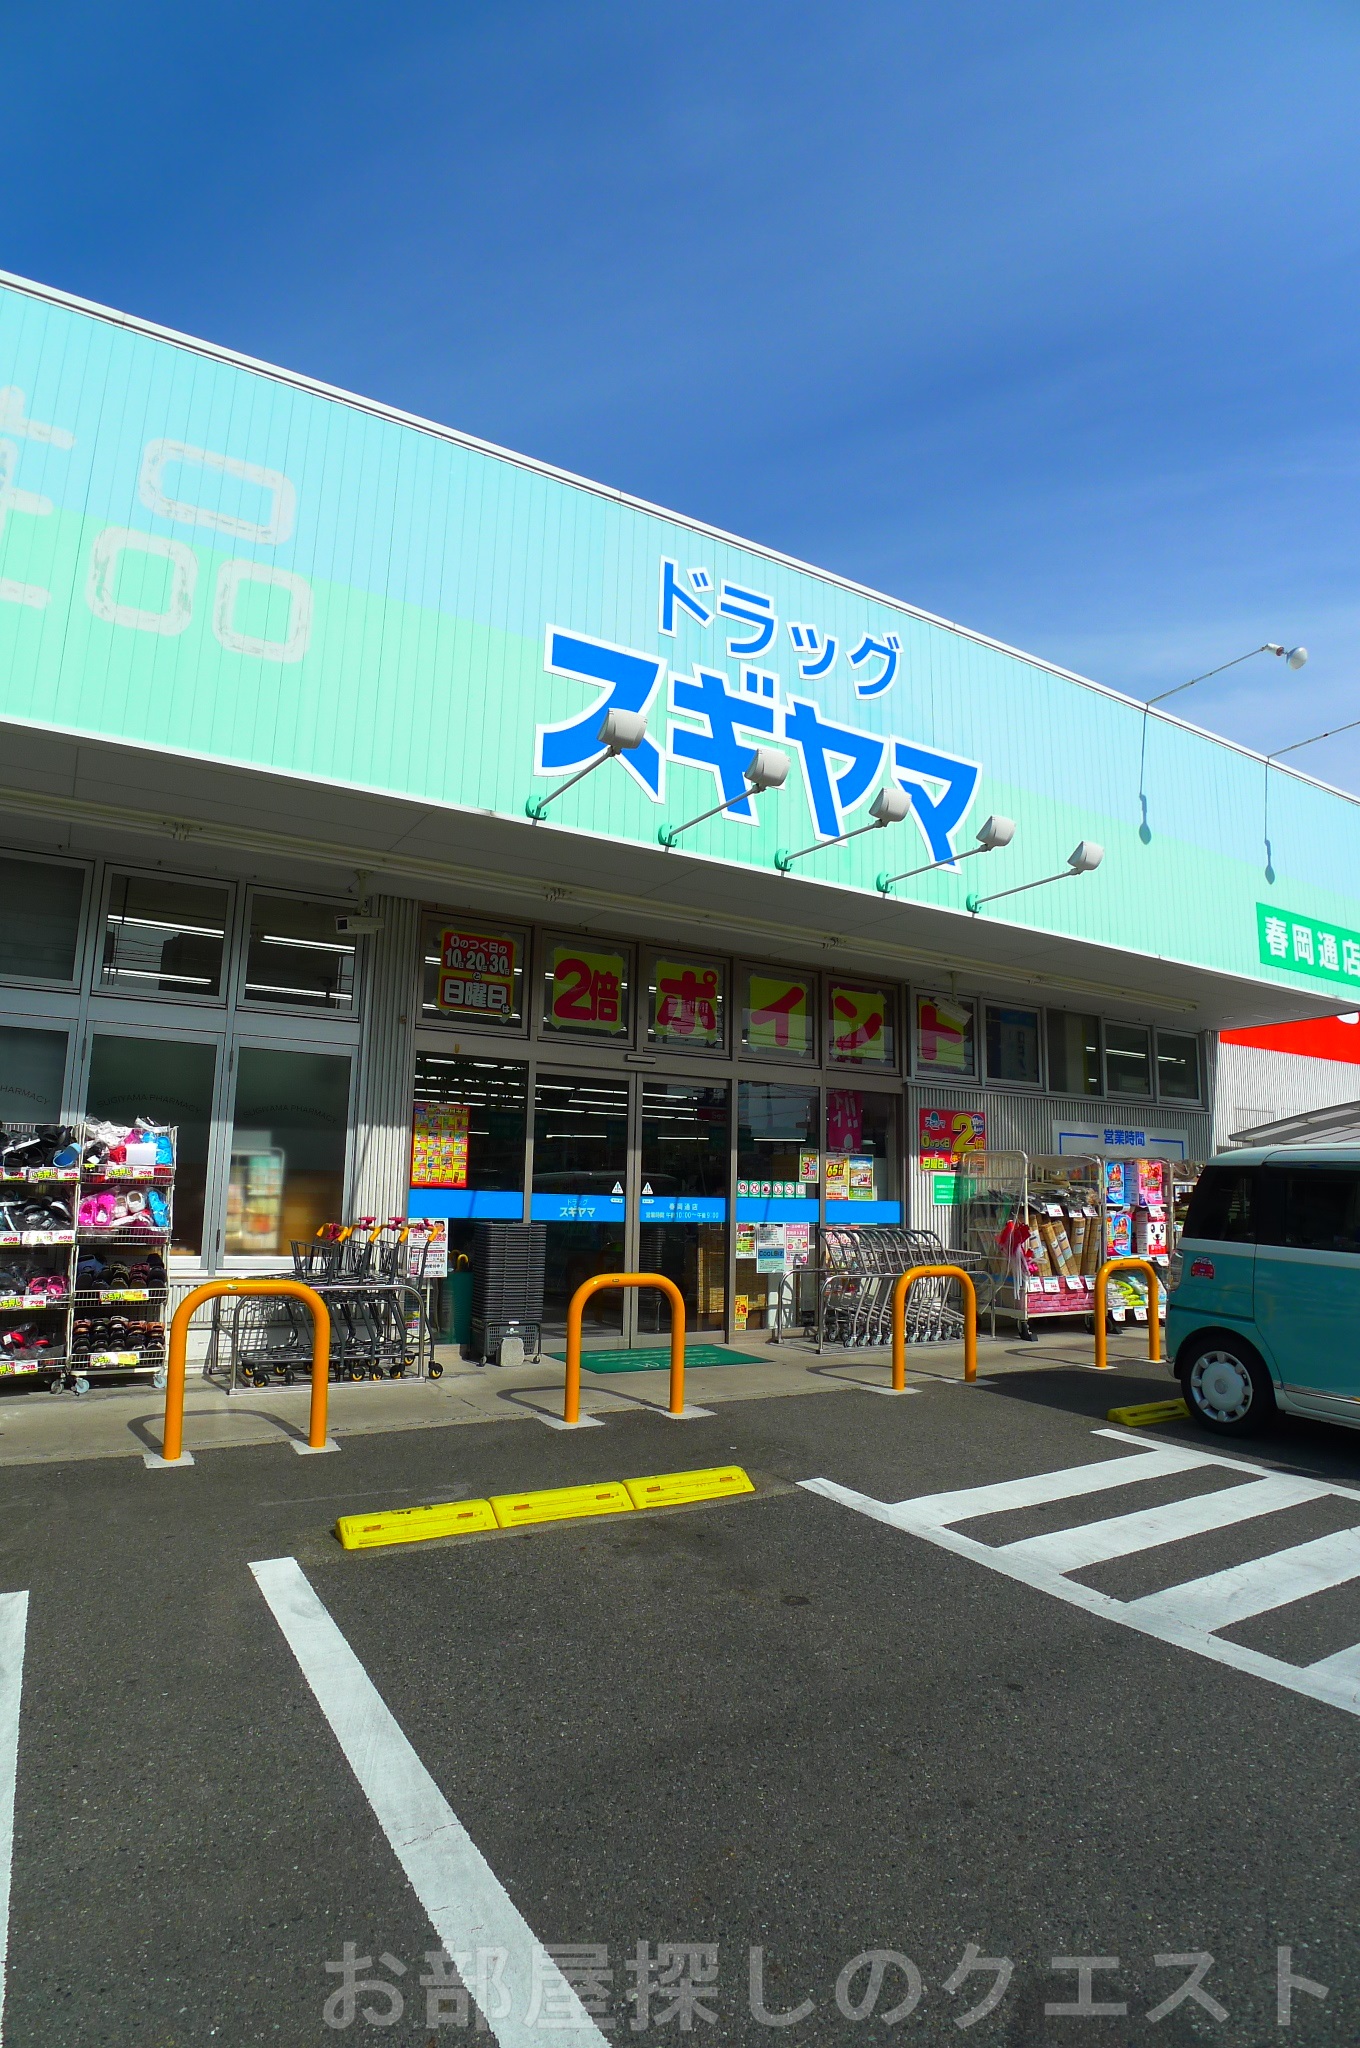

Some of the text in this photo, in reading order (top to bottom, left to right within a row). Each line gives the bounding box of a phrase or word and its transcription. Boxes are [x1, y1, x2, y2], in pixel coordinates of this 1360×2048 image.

[658, 555, 903, 700] ドラッグ
[533, 624, 983, 873] スギヤマ
[450, 935, 508, 954] 0のつく日の
[1264, 916, 1360, 978] 春岡通店
[554, 959, 619, 1023] 2倍
[97, 1093, 202, 1114] SUGIYAMA PHARMACY
[290, 1105, 337, 1124] PHARMACY
[1103, 1129, 1145, 1146] 営業時間
[559, 1206, 596, 1218] スギヤマ
[669, 1203, 698, 1211] 春岡通店
